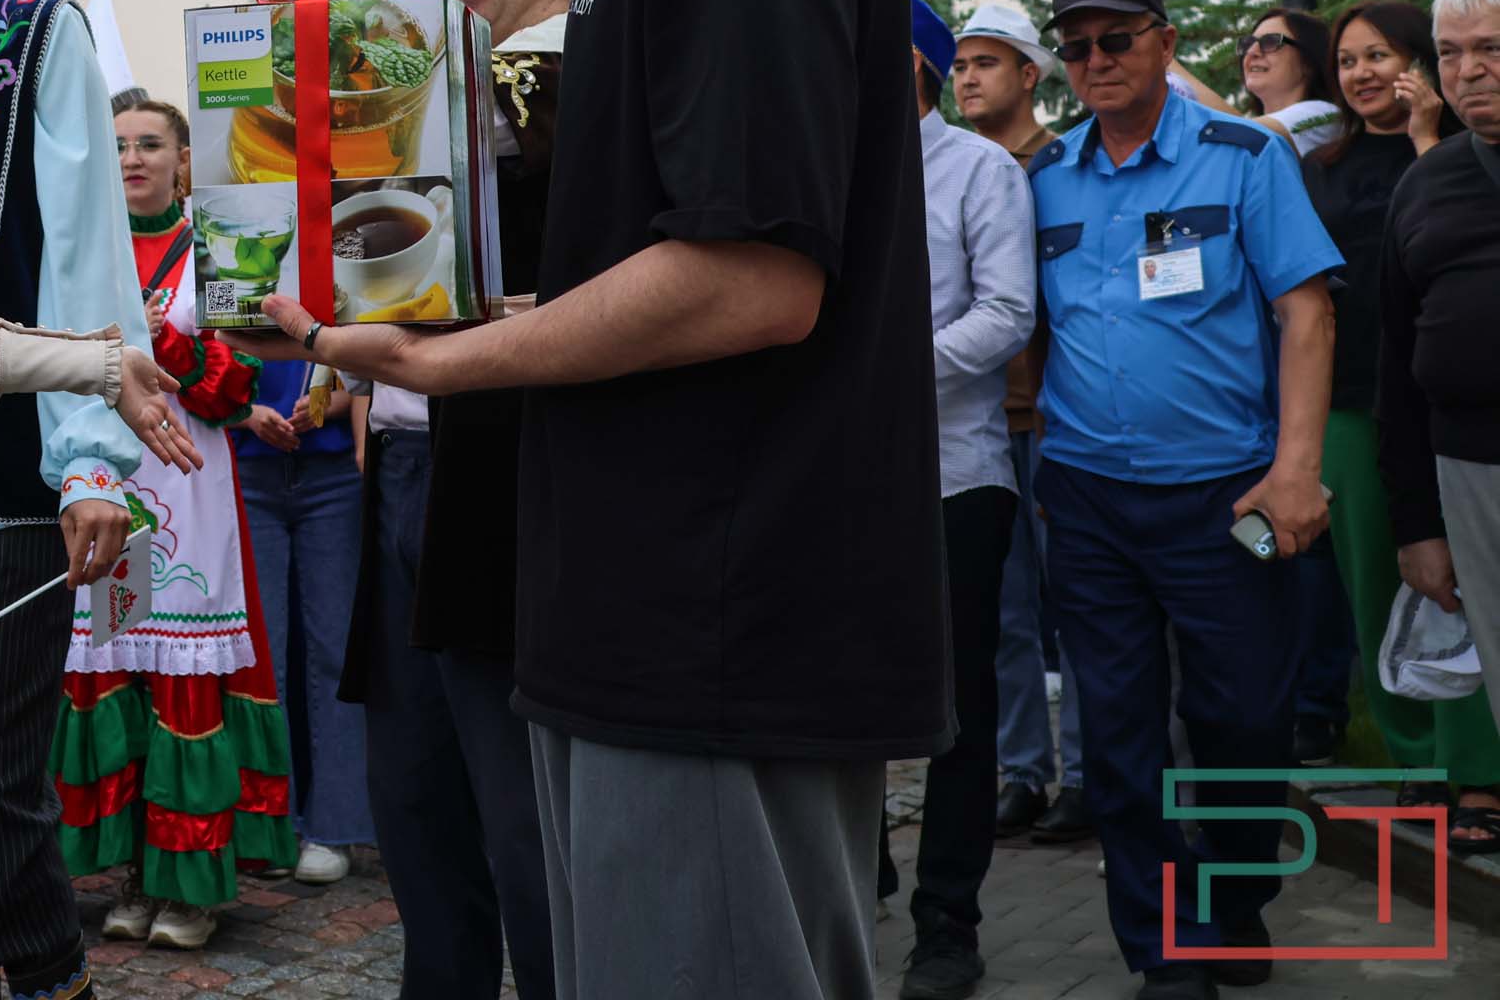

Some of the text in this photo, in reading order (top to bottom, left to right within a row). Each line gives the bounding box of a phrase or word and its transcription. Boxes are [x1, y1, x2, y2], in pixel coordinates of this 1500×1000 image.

[203, 28, 265, 44] PHILIPS
[205, 67, 247, 82] Kettle
[205, 93, 250, 104] 3000 Series
